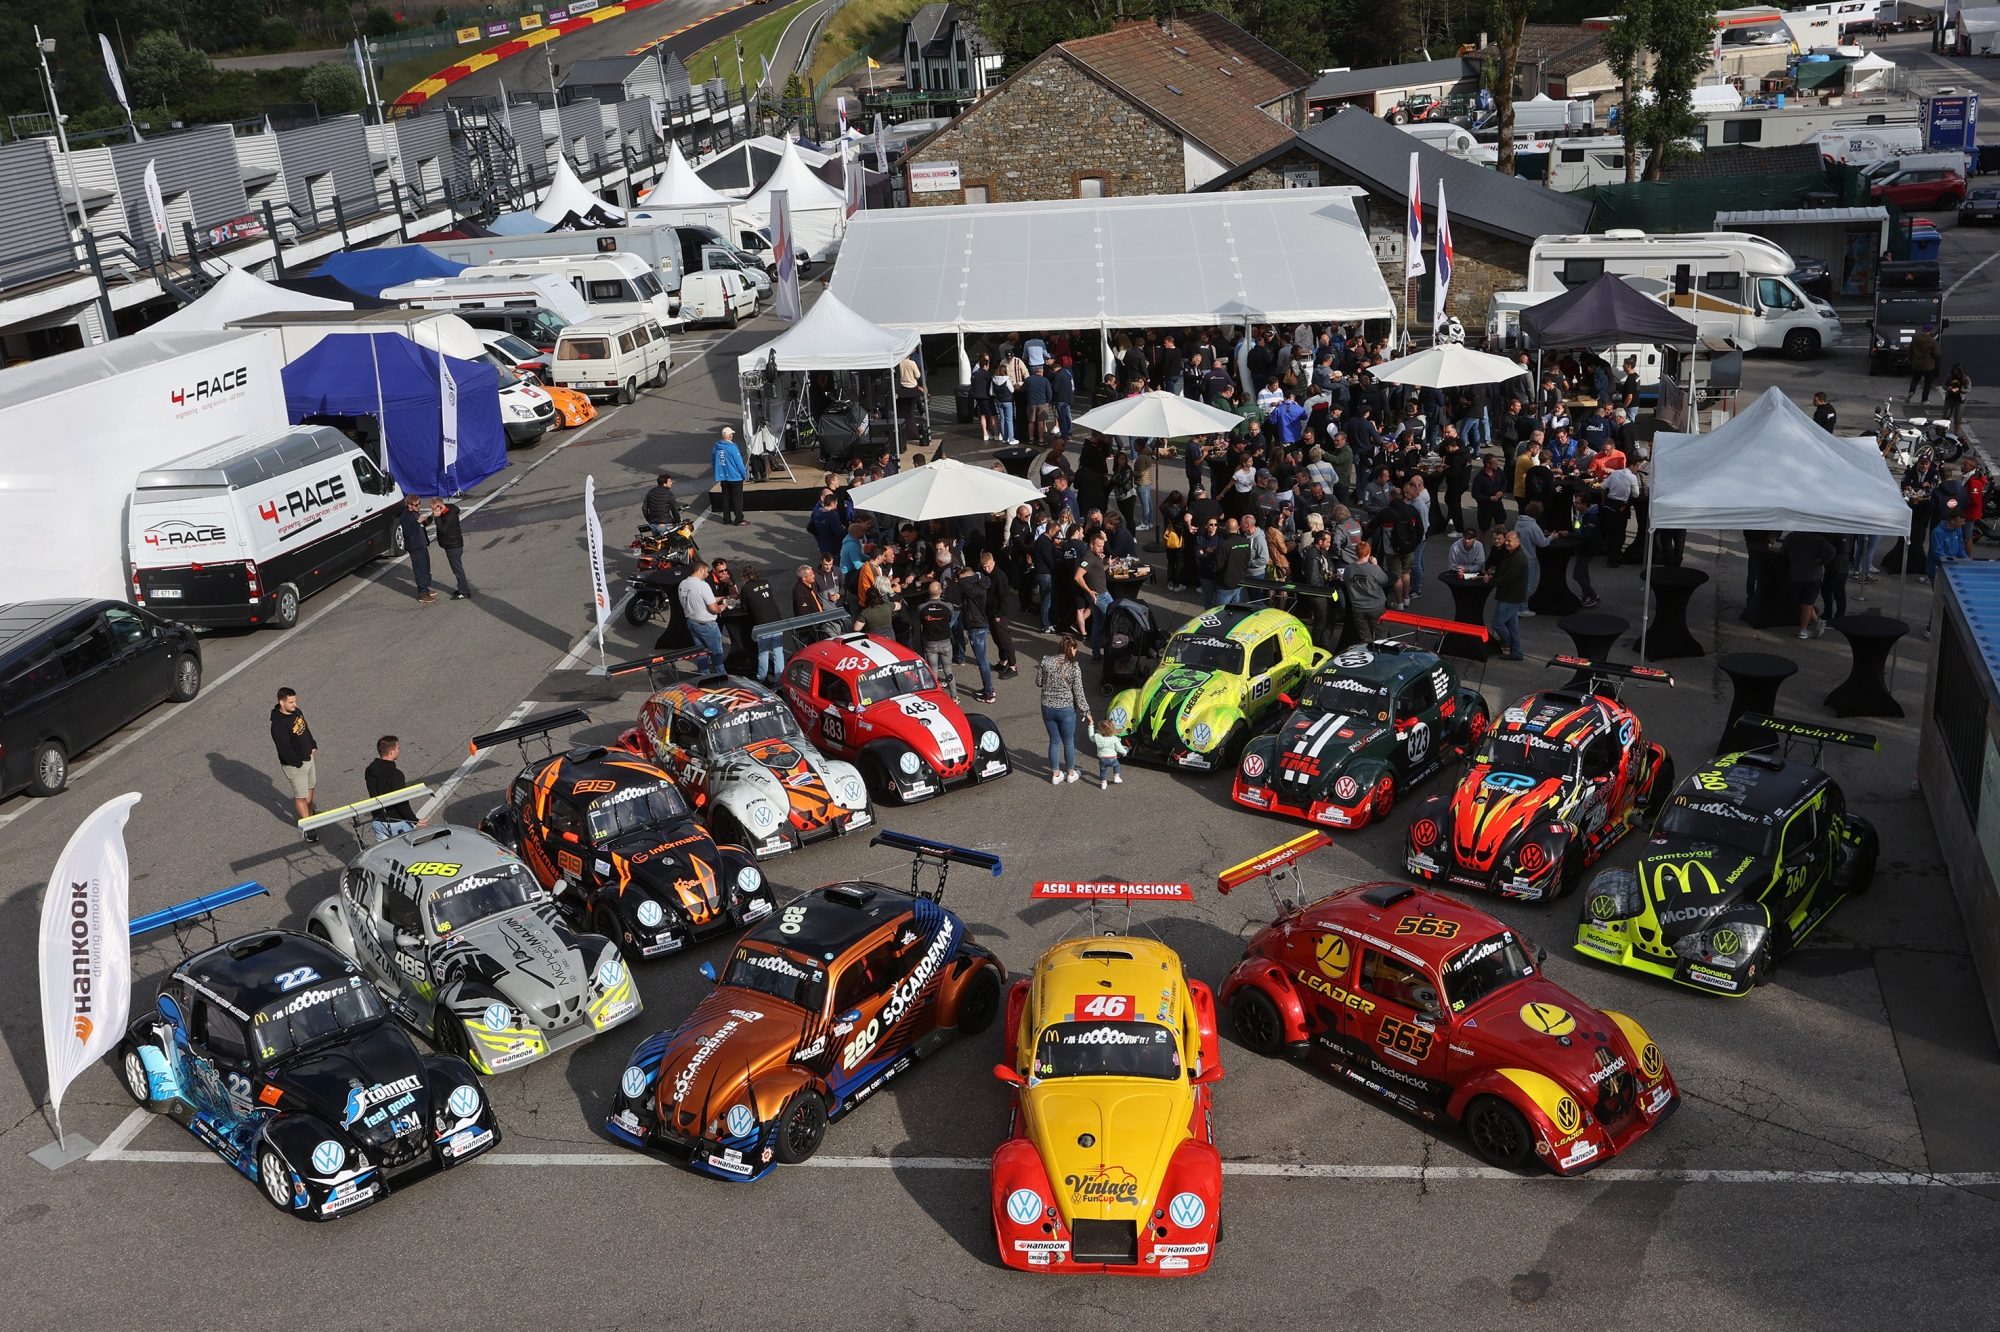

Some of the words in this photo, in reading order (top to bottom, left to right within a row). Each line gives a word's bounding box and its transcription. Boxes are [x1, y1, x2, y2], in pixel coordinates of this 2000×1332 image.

[171, 367, 247, 406] 4-RACE
[175, 408, 198, 420] engineering
[201, 402, 213, 411] racing
[213, 397, 228, 406] services
[258, 474, 347, 524] 4-RACE
[278, 520, 302, 533] engineering
[303, 514, 316, 523] racing
[315, 508, 331, 517] services
[145, 528, 226, 546] 4-RACE
[835, 657, 870, 672] 483
[861, 698, 872, 706] 483
[1184, 687, 1205, 715] CREDECO
[1251, 677, 1272, 702] 199
[789, 687, 819, 720] SHARP
[905, 699, 938, 715] 483
[823, 717, 843, 740] 483
[1761, 719, 1786, 730] I'm
[1789, 724, 1835, 738] lovin'
[1410, 726, 1429, 758] 323
[684, 764, 707, 787] 477
[649, 834, 705, 855] Informatic
[1647, 850, 1712, 862] comtoyou
[406, 862, 463, 877] 486
[1726, 855, 1755, 884] McDonald's
[1784, 865, 1807, 898] 260
[1042, 884, 1073, 894] ASBL
[1076, 884, 1116, 894] REVES
[1123, 885, 1183, 895] PASSIONS
[91, 878, 100, 931] emotion
[437, 921, 452, 932] 486
[779, 907, 808, 934] 280
[1394, 915, 1461, 940] 563
[1586, 932, 1622, 949] McDonald's
[93, 932, 104, 978] driving
[394, 950, 426, 981] 486
[274, 966, 322, 992] 22
[883, 916, 954, 1026] SOCARDENNE
[1690, 964, 1732, 980] McDonald's
[1297, 969, 1376, 1016] LEADER
[895, 990, 921, 1022] QUALITY
[1084, 996, 1128, 1017] 46
[1452, 1000, 1465, 1013] 563
[843, 1018, 879, 1071] 280
[1376, 1014, 1434, 1061] 563
[261, 1047, 275, 1059] 22
[673, 1020, 739, 1103] SOCARDENNE
[685, 1066, 702, 1095] QUALITY
[702, 1027, 737, 1065] ALIMENTATION
[1040, 1064, 1053, 1074] 46
[229, 1072, 252, 1103] 22
[367, 1074, 421, 1103] CONTACT
[1366, 1080, 1398, 1100] comtoyou
[363, 1107, 389, 1129] feel
[387, 1091, 416, 1116] good
[395, 1124, 422, 1139] RACING
[1554, 1127, 1585, 1148] LEADER
[1065, 1174, 1138, 1203] Vintage
[1083, 1194, 1114, 1205] FunCup
